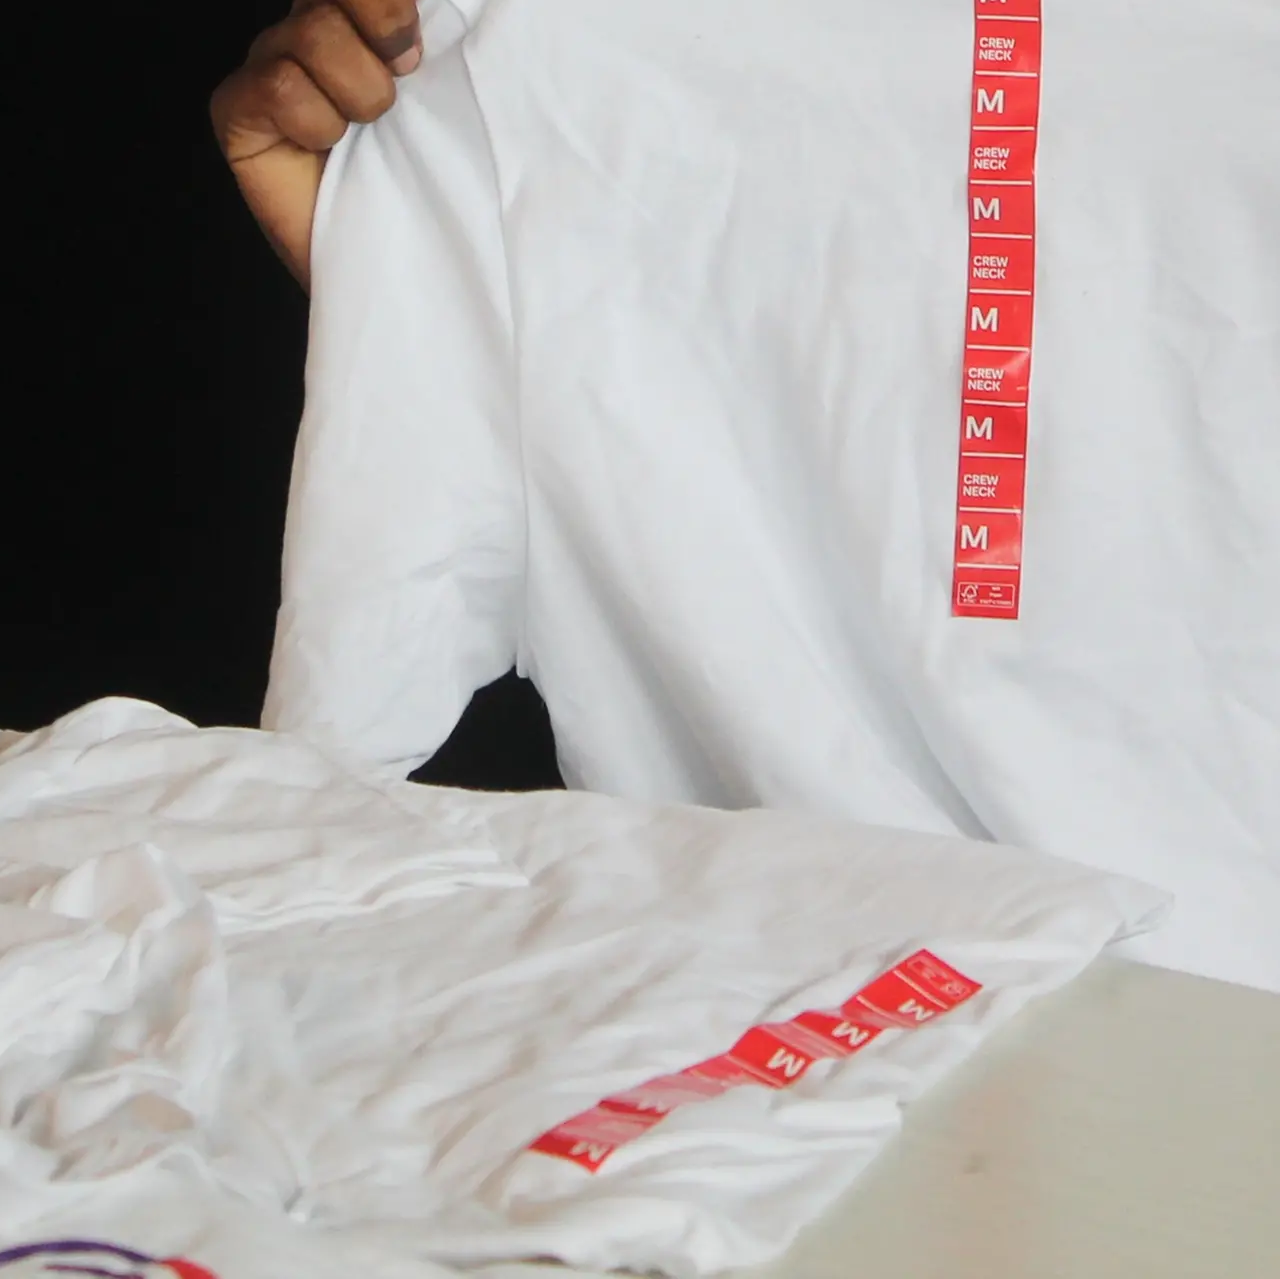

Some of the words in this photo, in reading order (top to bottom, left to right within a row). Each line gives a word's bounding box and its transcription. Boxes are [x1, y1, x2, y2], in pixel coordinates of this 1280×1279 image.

[979, 36, 1015, 49] CREW
[979, 49, 1012, 61] NECK
[976, 88, 1004, 114] M
[974, 147, 1010, 159] CREW
[973, 159, 1006, 170] NECK
[973, 197, 1000, 221] M
[973, 255, 1008, 268] CREW
[973, 268, 1006, 280] NECK
[971, 306, 998, 332] M
[968, 367, 1004, 380] CREW
[967, 379, 1001, 391] NECK
[965, 416, 993, 440] M
[963, 474, 999, 486] CREW
[963, 486, 996, 498] NECK
[960, 524, 988, 550] M
[831, 1021, 869, 1046] M
[766, 1047, 806, 1078] M
